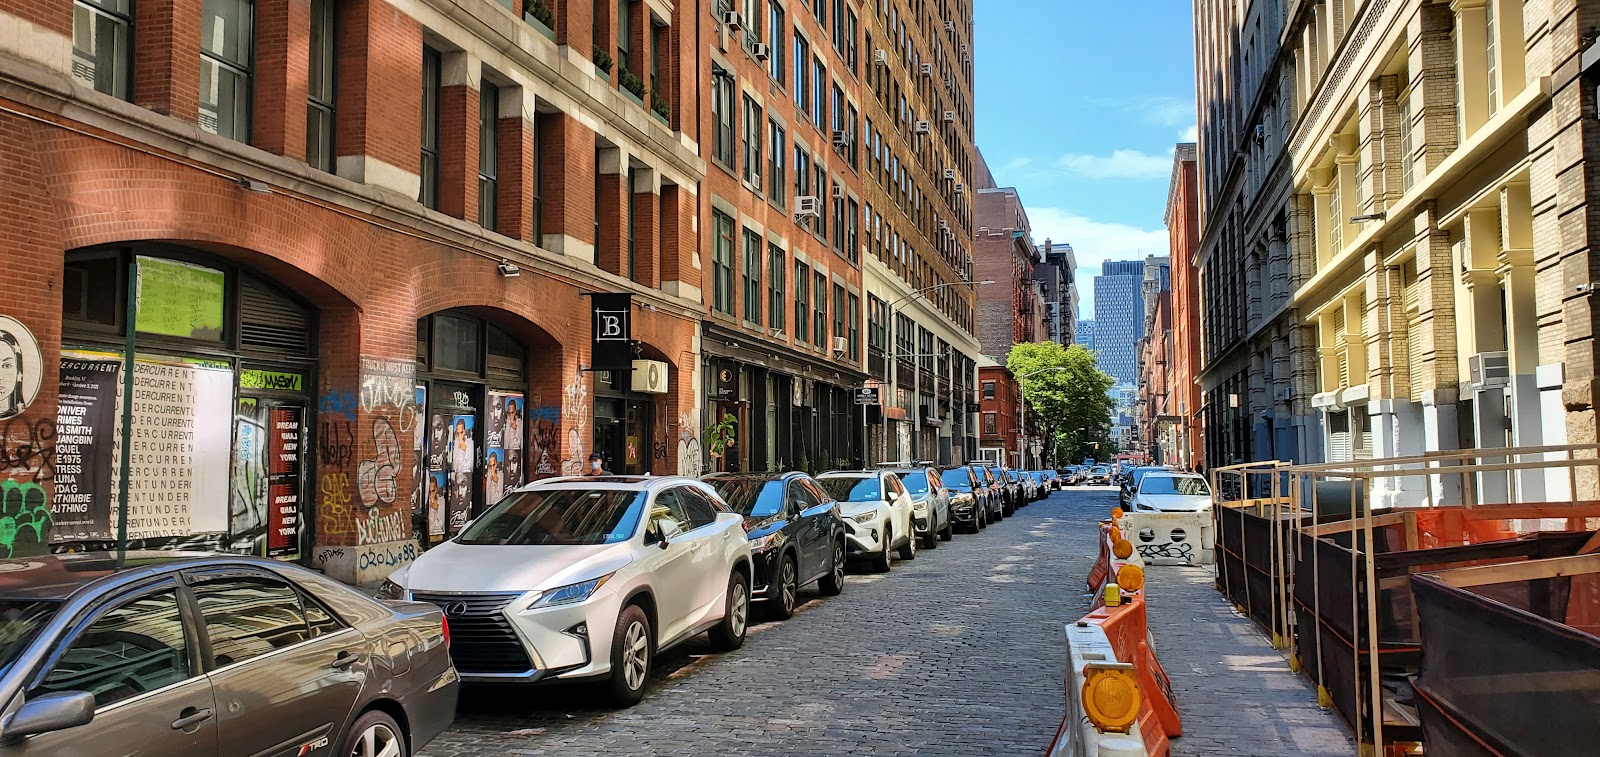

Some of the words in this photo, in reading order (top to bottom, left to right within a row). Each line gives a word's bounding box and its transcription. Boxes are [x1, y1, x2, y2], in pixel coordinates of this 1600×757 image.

[361, 358, 385, 371] TRUCKS
[386, 361, 402, 373] MUST
[402, 363, 415, 374] KEEP
[277, 421, 298, 429] DREAM
[66, 426, 93, 435] SMITH
[283, 443, 297, 451] NEW
[62, 494, 92, 503] KIMBIE
[275, 495, 297, 504] DREAM
[61, 503, 88, 513] THING
[282, 516, 297, 525] NEW
[279, 527, 296, 536] YORK
[309, 737, 329, 751] TRD
